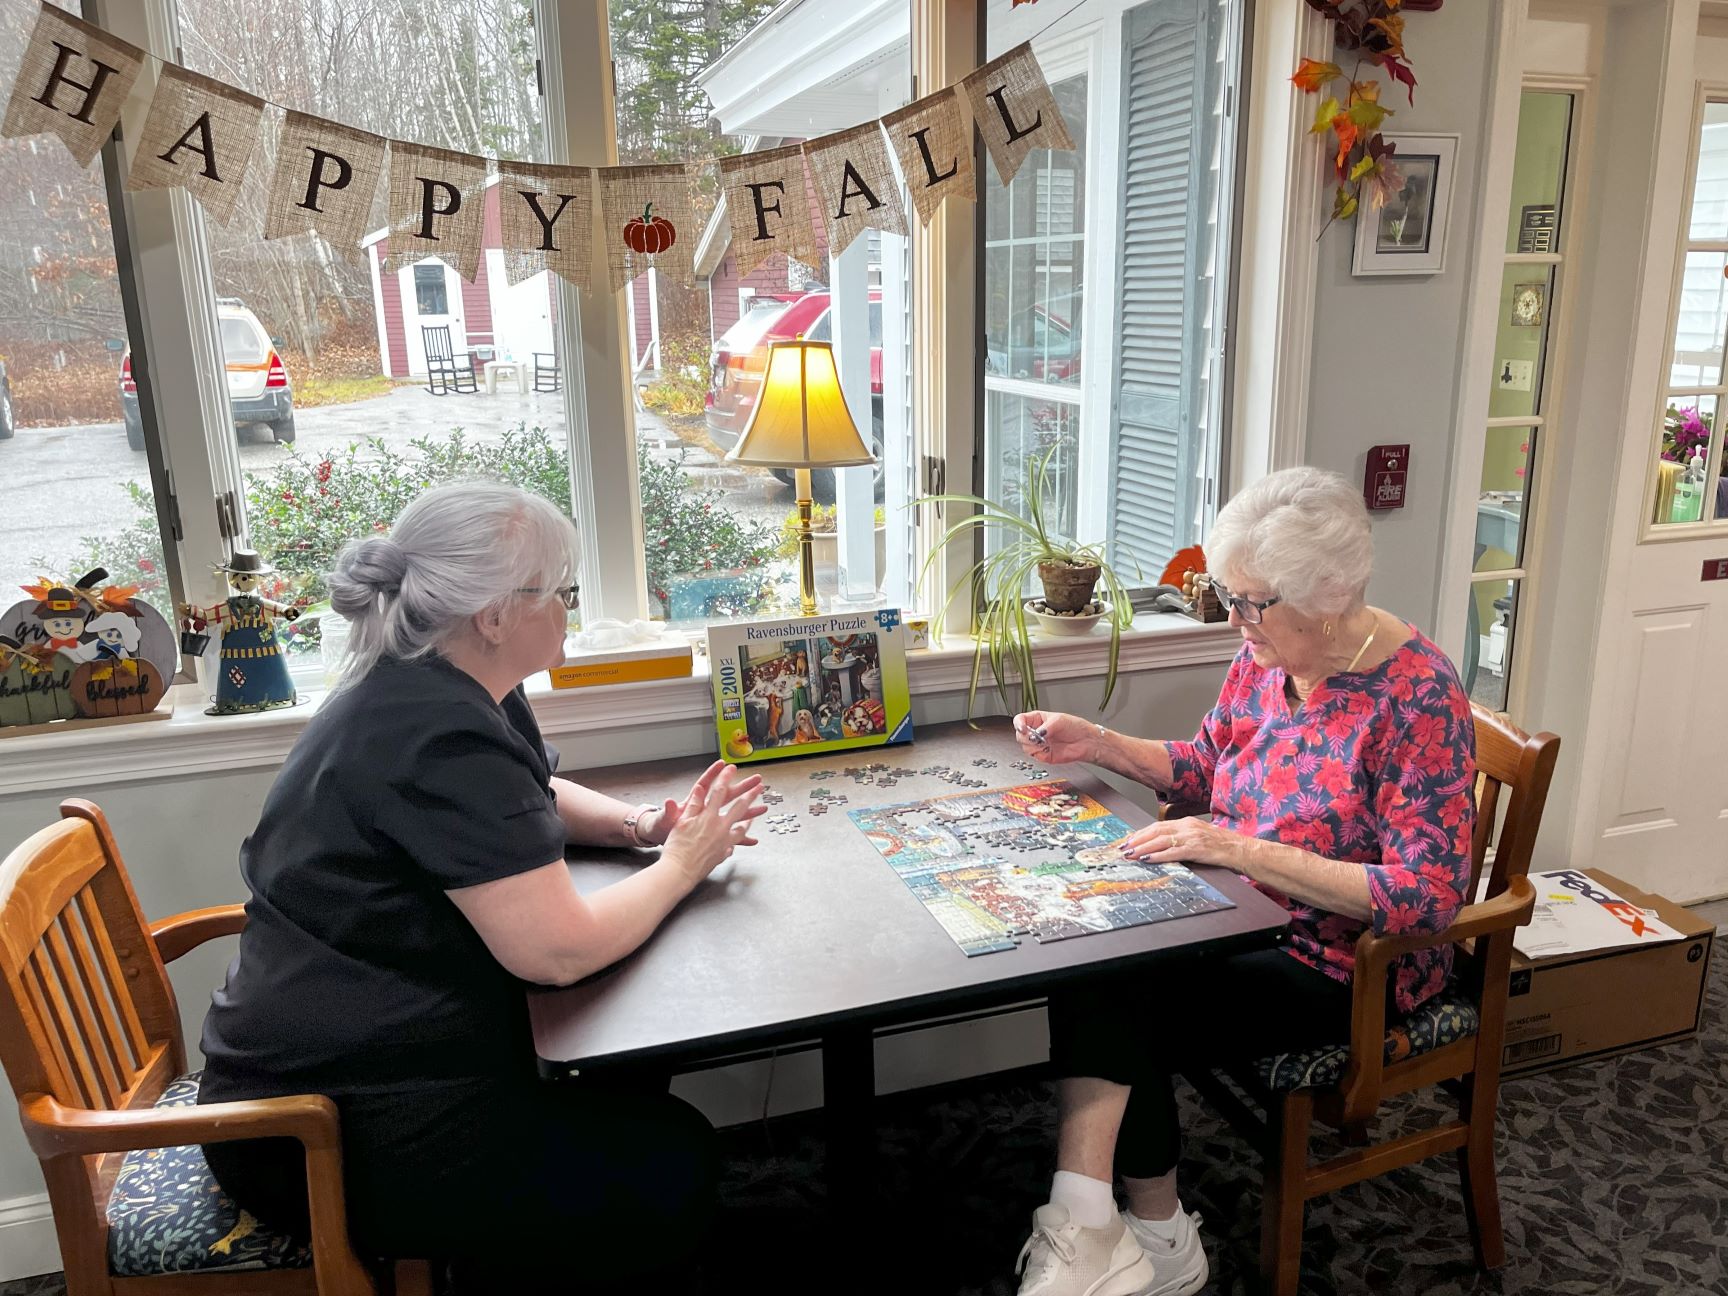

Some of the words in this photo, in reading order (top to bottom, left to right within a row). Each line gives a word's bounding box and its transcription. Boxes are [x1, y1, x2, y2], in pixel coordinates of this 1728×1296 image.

[31, 41, 577, 252] HAPPY
[744, 84, 1043, 241] FALL
[1377, 485, 1402, 496] FIRE
[746, 622, 827, 640] Ravensburger
[830, 617, 867, 631] Puzzle
[0, 670, 70, 698] hankful
[720, 666, 737, 695] 200
[1540, 870, 1662, 938] FedEx
